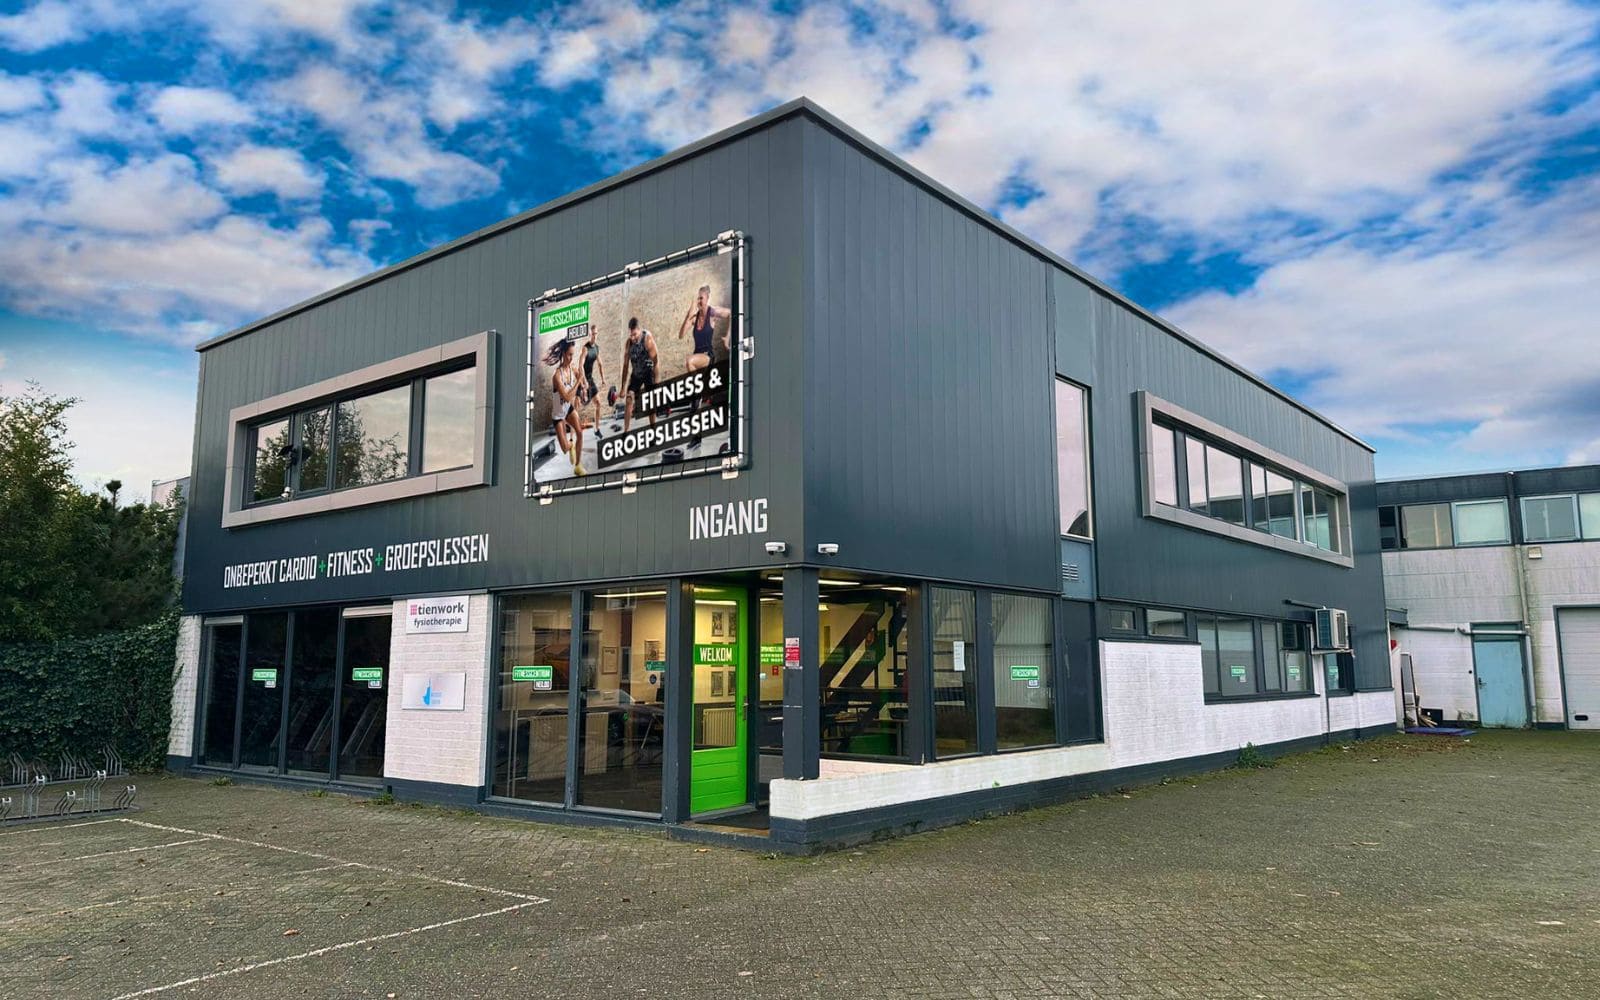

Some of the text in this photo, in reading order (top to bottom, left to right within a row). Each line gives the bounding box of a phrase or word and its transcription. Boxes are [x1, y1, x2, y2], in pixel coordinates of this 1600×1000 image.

[540, 305, 588, 331] FITNESSCENTRUM
[641, 368, 723, 412] FITNESS &
[601, 406, 725, 461] GROEPSLESSEN
[690, 498, 767, 540] INGANG
[223, 560, 278, 589] ONBEPERKT
[278, 555, 318, 583] CARDIO
[327, 548, 373, 578] FITNESS
[385, 533, 489, 572] GROEPSLESSEN
[413, 616, 462, 627] fysiotherapie
[417, 602, 465, 615] tienwork
[699, 647, 733, 662] WELKOM
